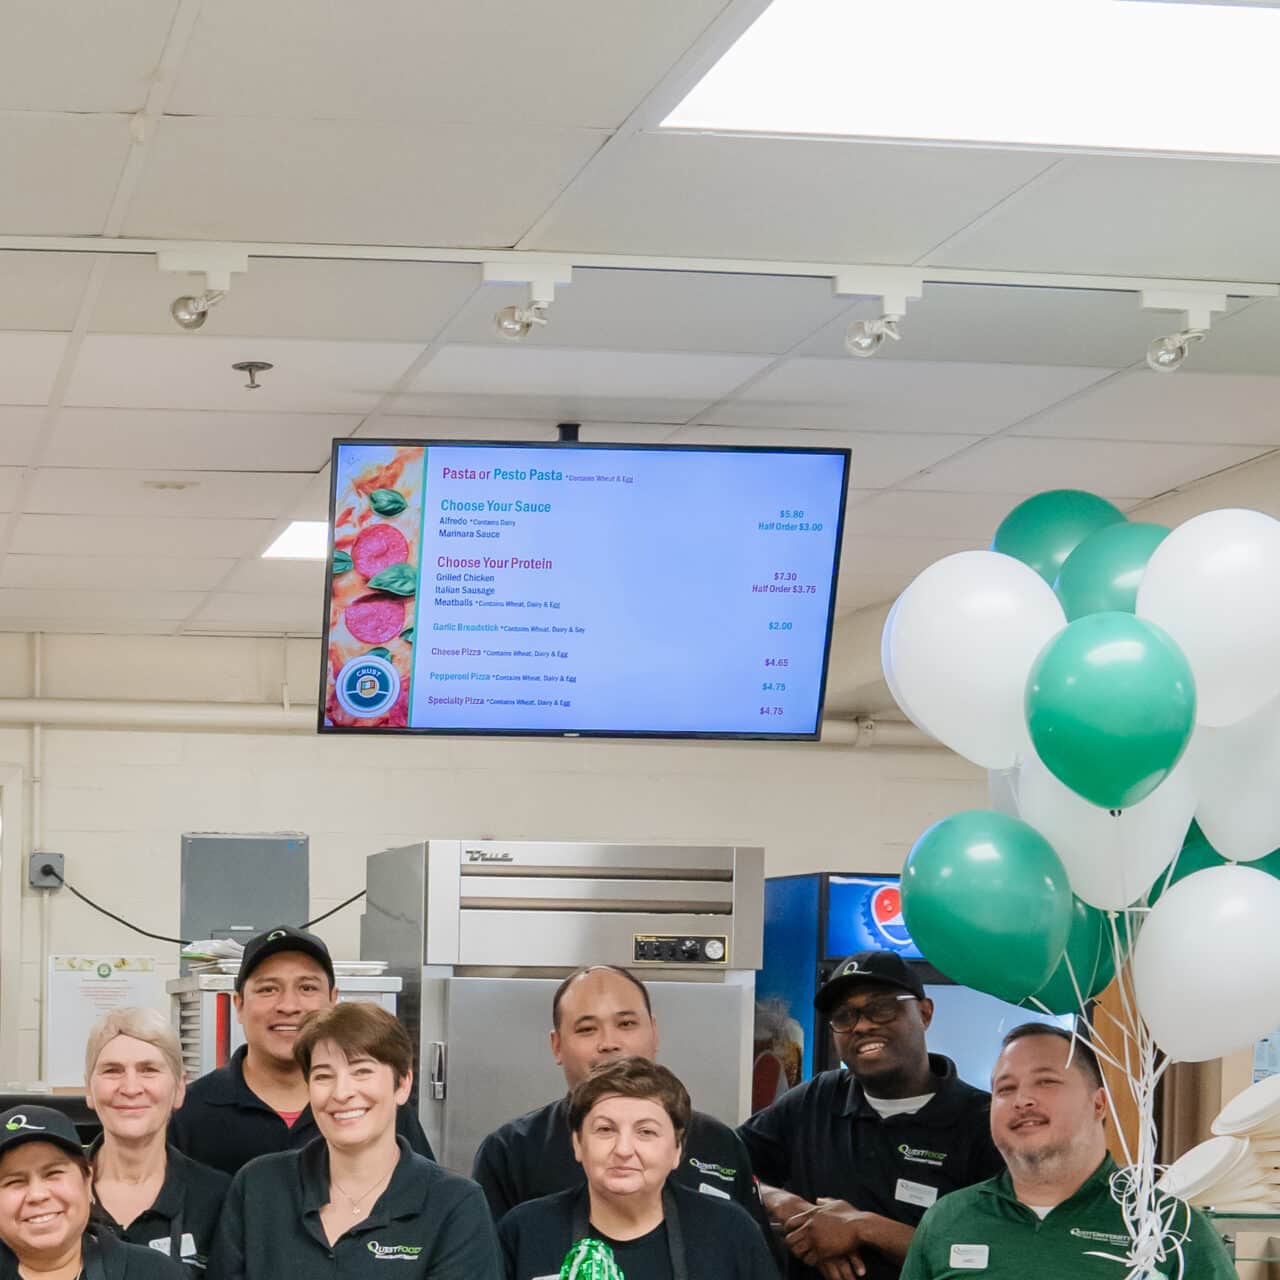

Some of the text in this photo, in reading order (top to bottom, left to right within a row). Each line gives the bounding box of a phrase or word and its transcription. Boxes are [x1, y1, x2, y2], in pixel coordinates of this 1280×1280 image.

[443, 467, 476, 480] Pasta
[479, 469, 491, 480] or
[494, 468, 526, 481] Pesto
[529, 468, 563, 481] Pasta
[441, 499, 551, 513] Choose Your Sauce
[780, 510, 804, 518] $5.80
[440, 517, 467, 526] Alfredo
[758, 522, 823, 531] Half Order $3.00
[438, 529, 500, 538] Marinara Sauce
[437, 556, 553, 570] Choose Your Protein
[436, 573, 495, 582] Grilled Chicken
[774, 572, 797, 581] $7.30
[435, 586, 495, 595] Italian Sausage
[752, 584, 816, 594] Half Order $3.75
[434, 598, 473, 607] Meatballs
[433, 623, 456, 632] Garlic
[457, 623, 499, 632] Breadstick
[768, 622, 793, 630] $2.00
[431, 647, 460, 656] Cheese
[461, 648, 481, 656] Pizza
[356, 668, 381, 677] CRUST
[430, 672, 470, 682] Pepperoni
[471, 672, 491, 681] Pizza
[428, 696, 463, 706] Specialty
[464, 697, 485, 705] Pizza
[465, 850, 513, 862] True
[368, 1241, 423, 1255] QUESTFOOD
